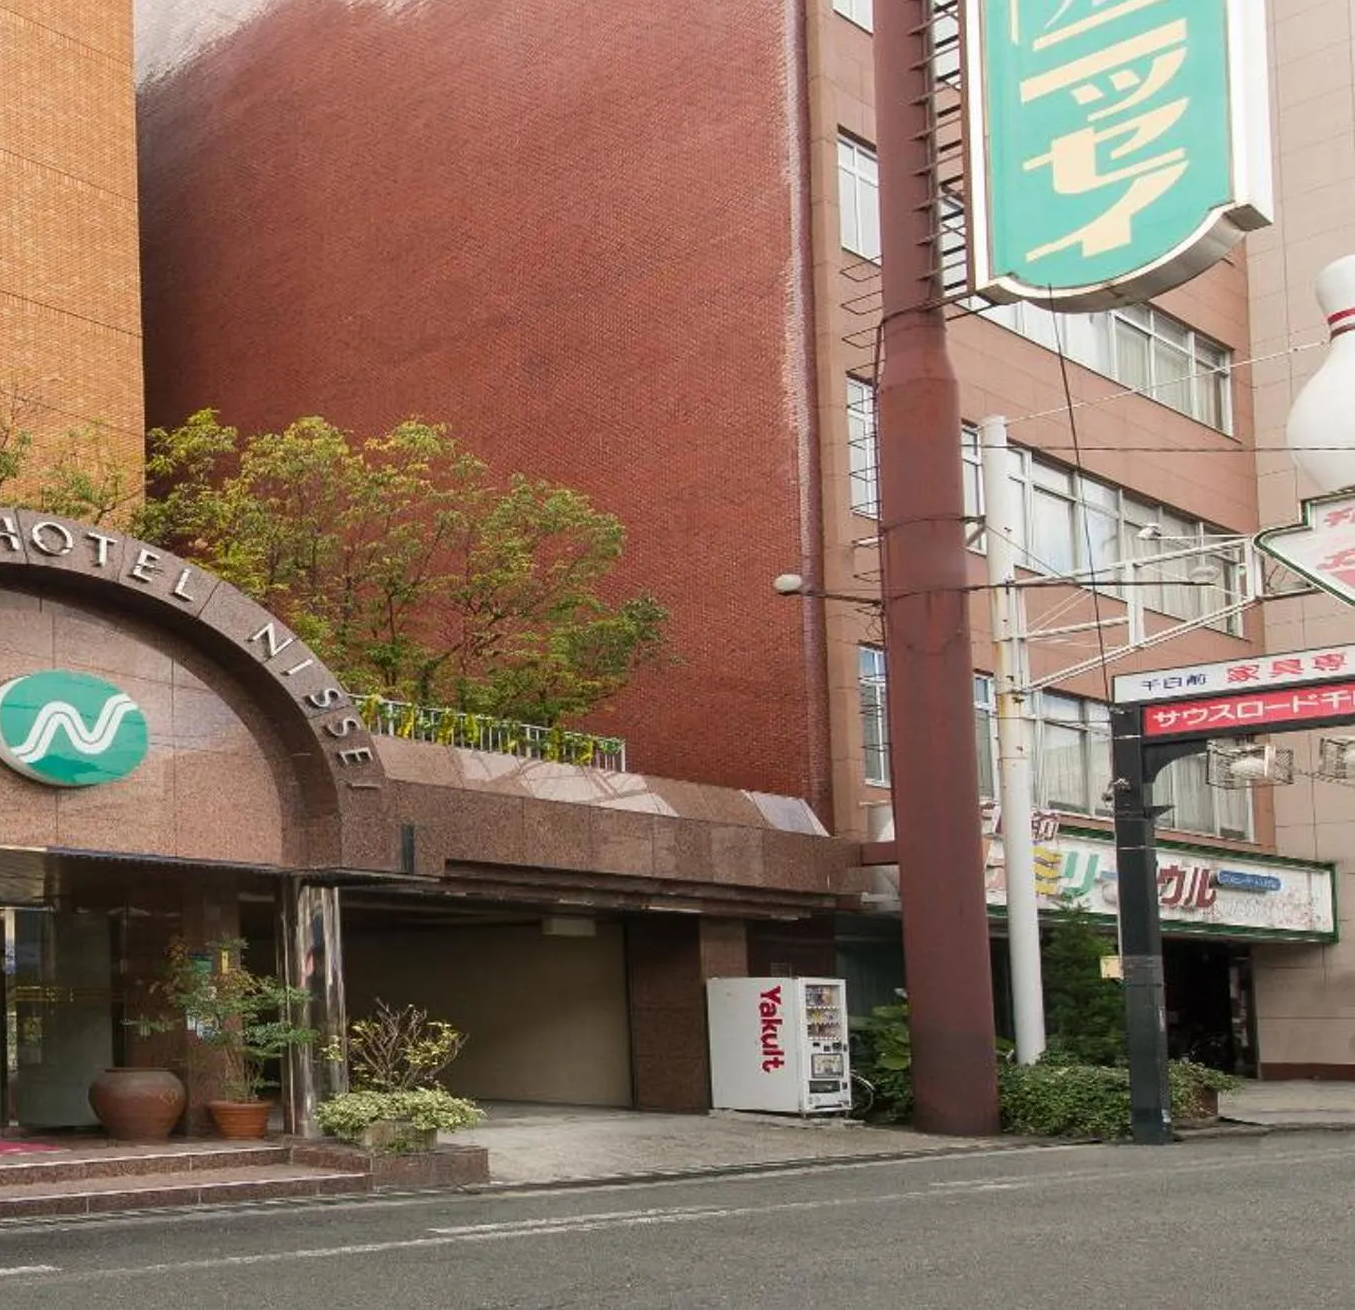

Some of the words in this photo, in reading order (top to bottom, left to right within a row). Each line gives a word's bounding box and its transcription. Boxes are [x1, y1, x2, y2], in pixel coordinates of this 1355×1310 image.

[248, 621, 383, 789] NISSEI
[1153, 689, 1355, 728] サウスロード千
[759, 985, 785, 1074] Yakult
